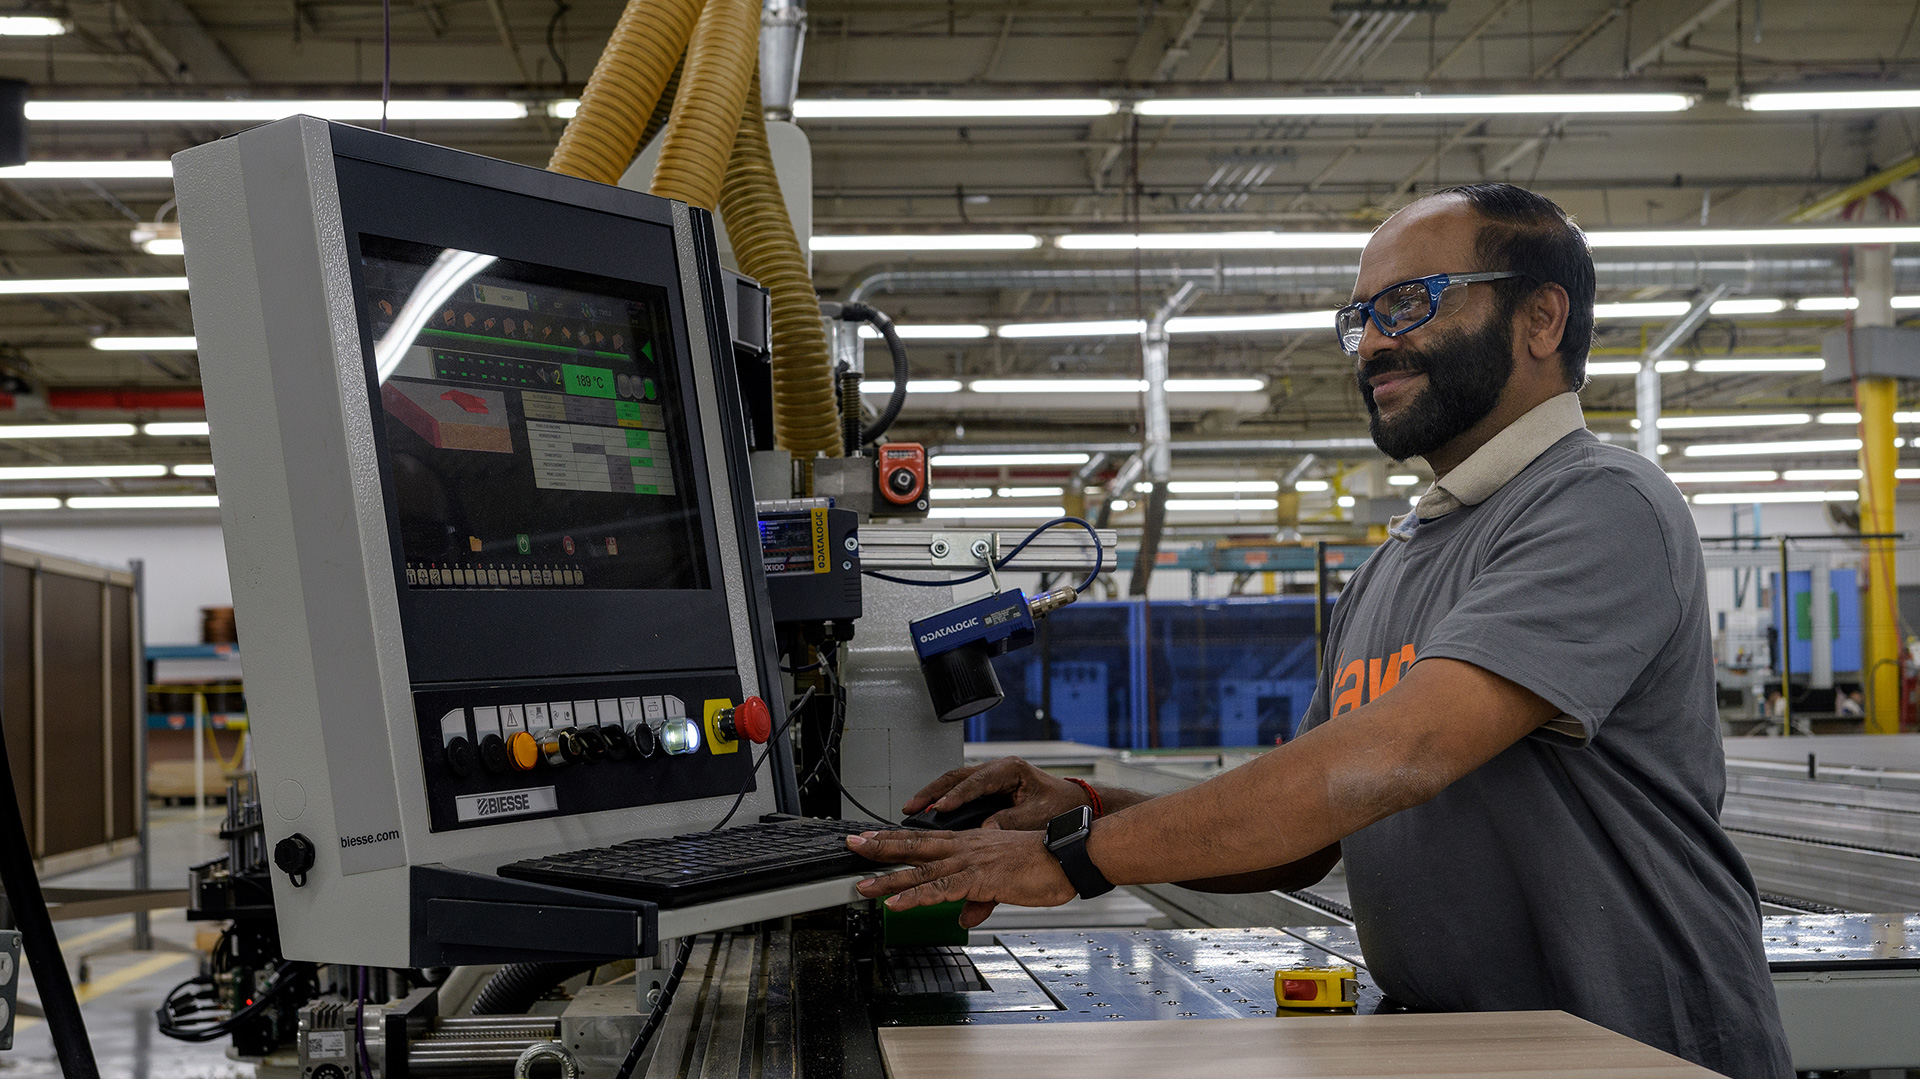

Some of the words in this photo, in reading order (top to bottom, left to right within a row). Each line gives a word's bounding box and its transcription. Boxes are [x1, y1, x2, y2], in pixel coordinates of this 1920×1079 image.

[554, 370, 561, 385] 2
[576, 374, 591, 387] 189
[927, 617, 979, 641] DATALOGIC
[488, 794, 530, 814] BIESSE
[340, 829, 400, 848] biesse.com
